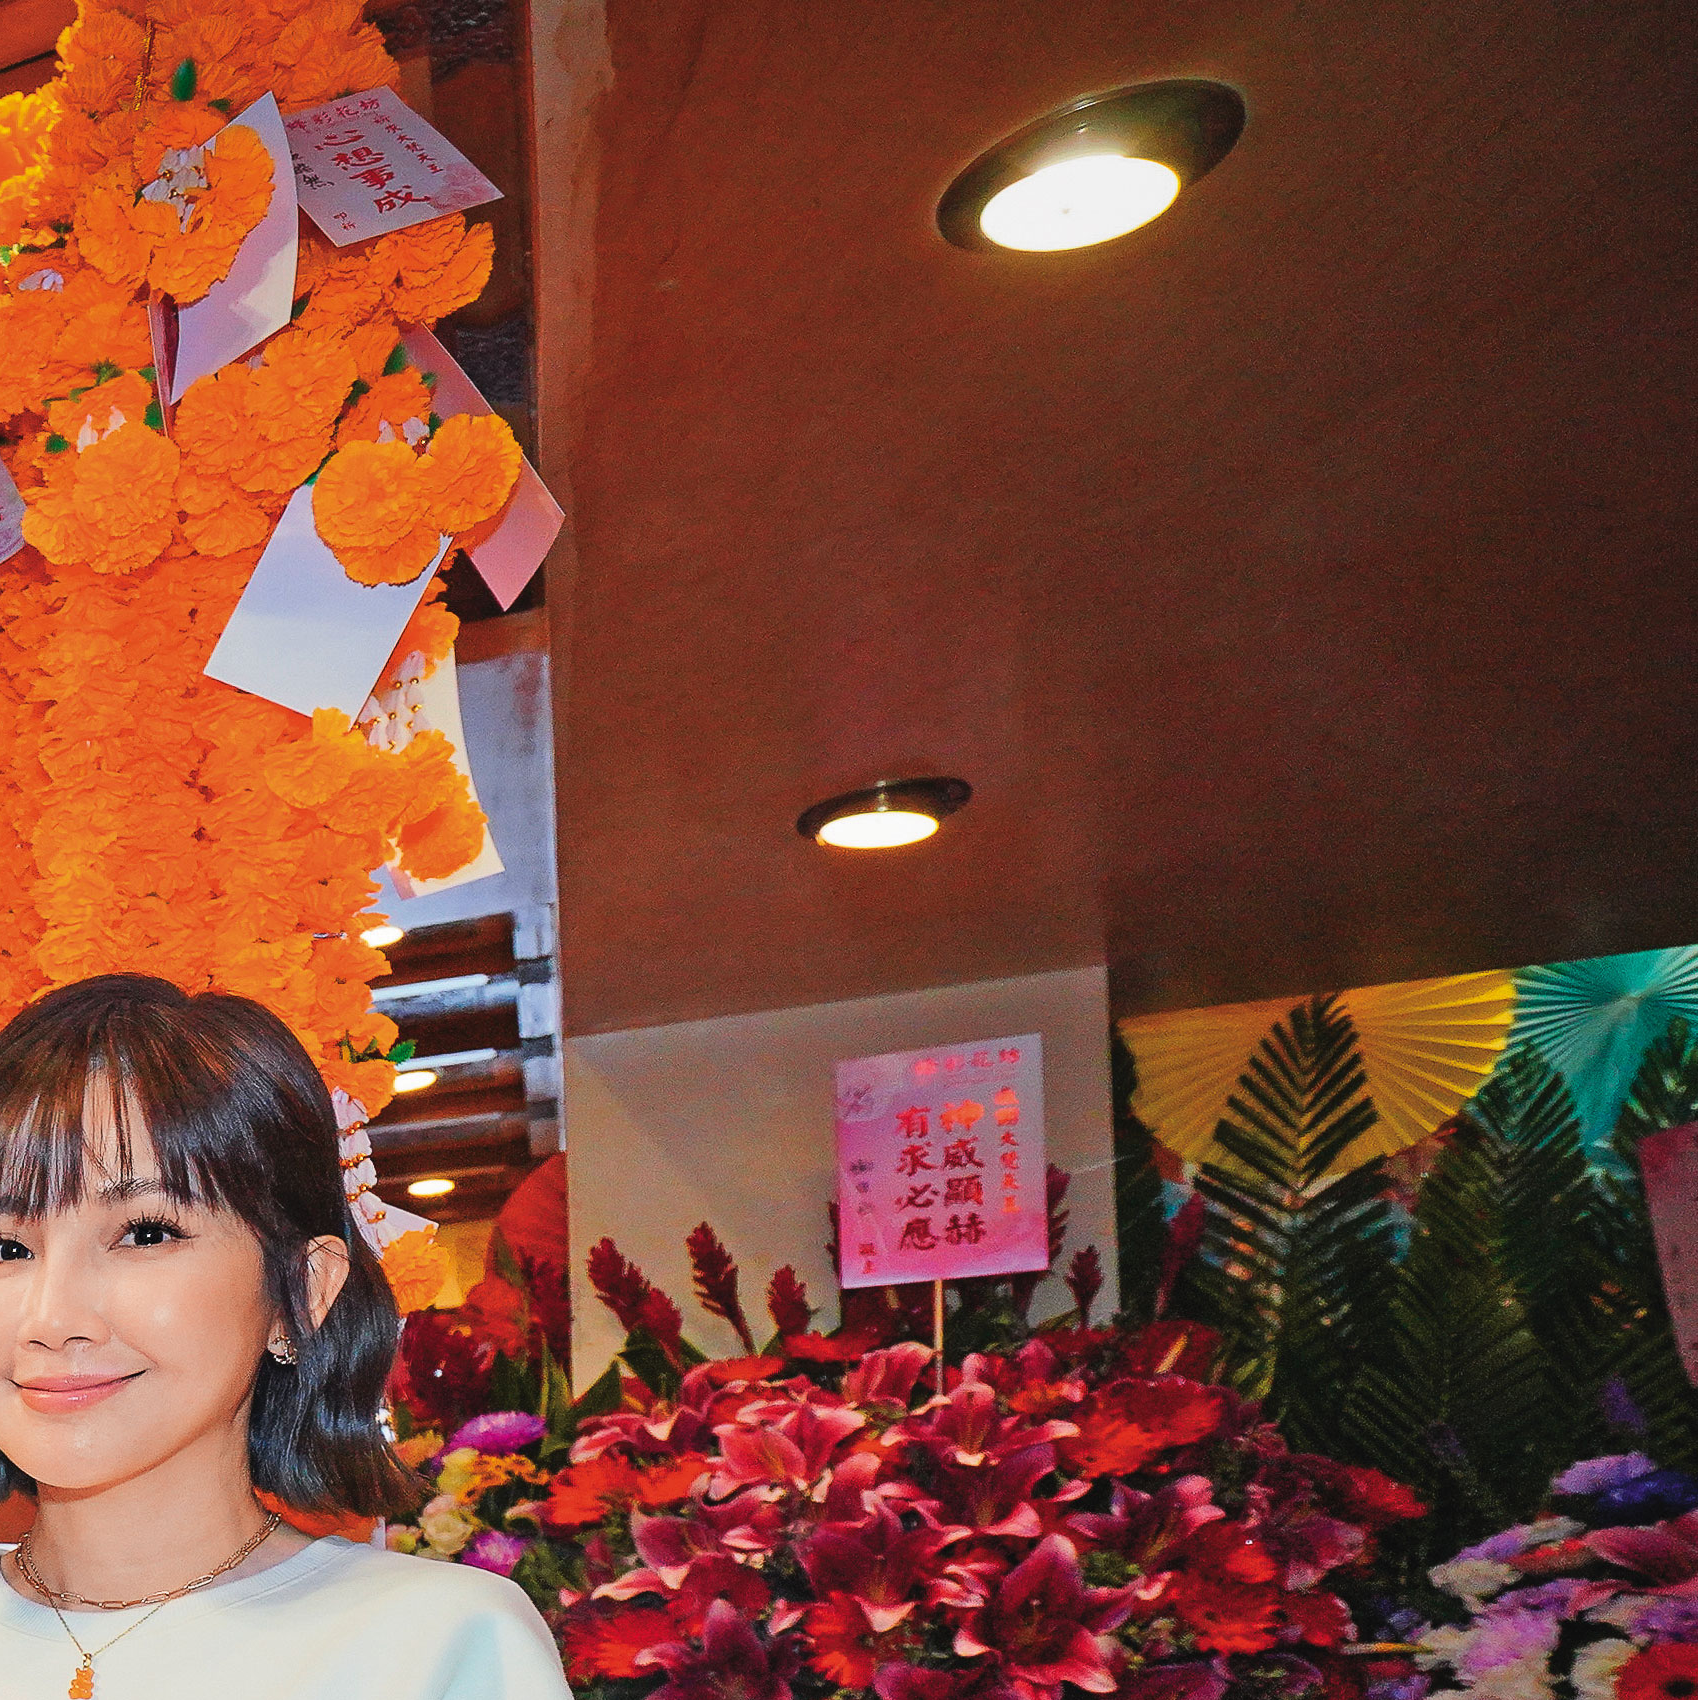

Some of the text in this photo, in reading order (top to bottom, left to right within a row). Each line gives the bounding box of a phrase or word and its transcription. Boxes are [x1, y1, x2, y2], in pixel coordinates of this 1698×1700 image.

[314, 129, 432, 214] 心想事成
[896, 1105, 940, 1251] 有求必應
